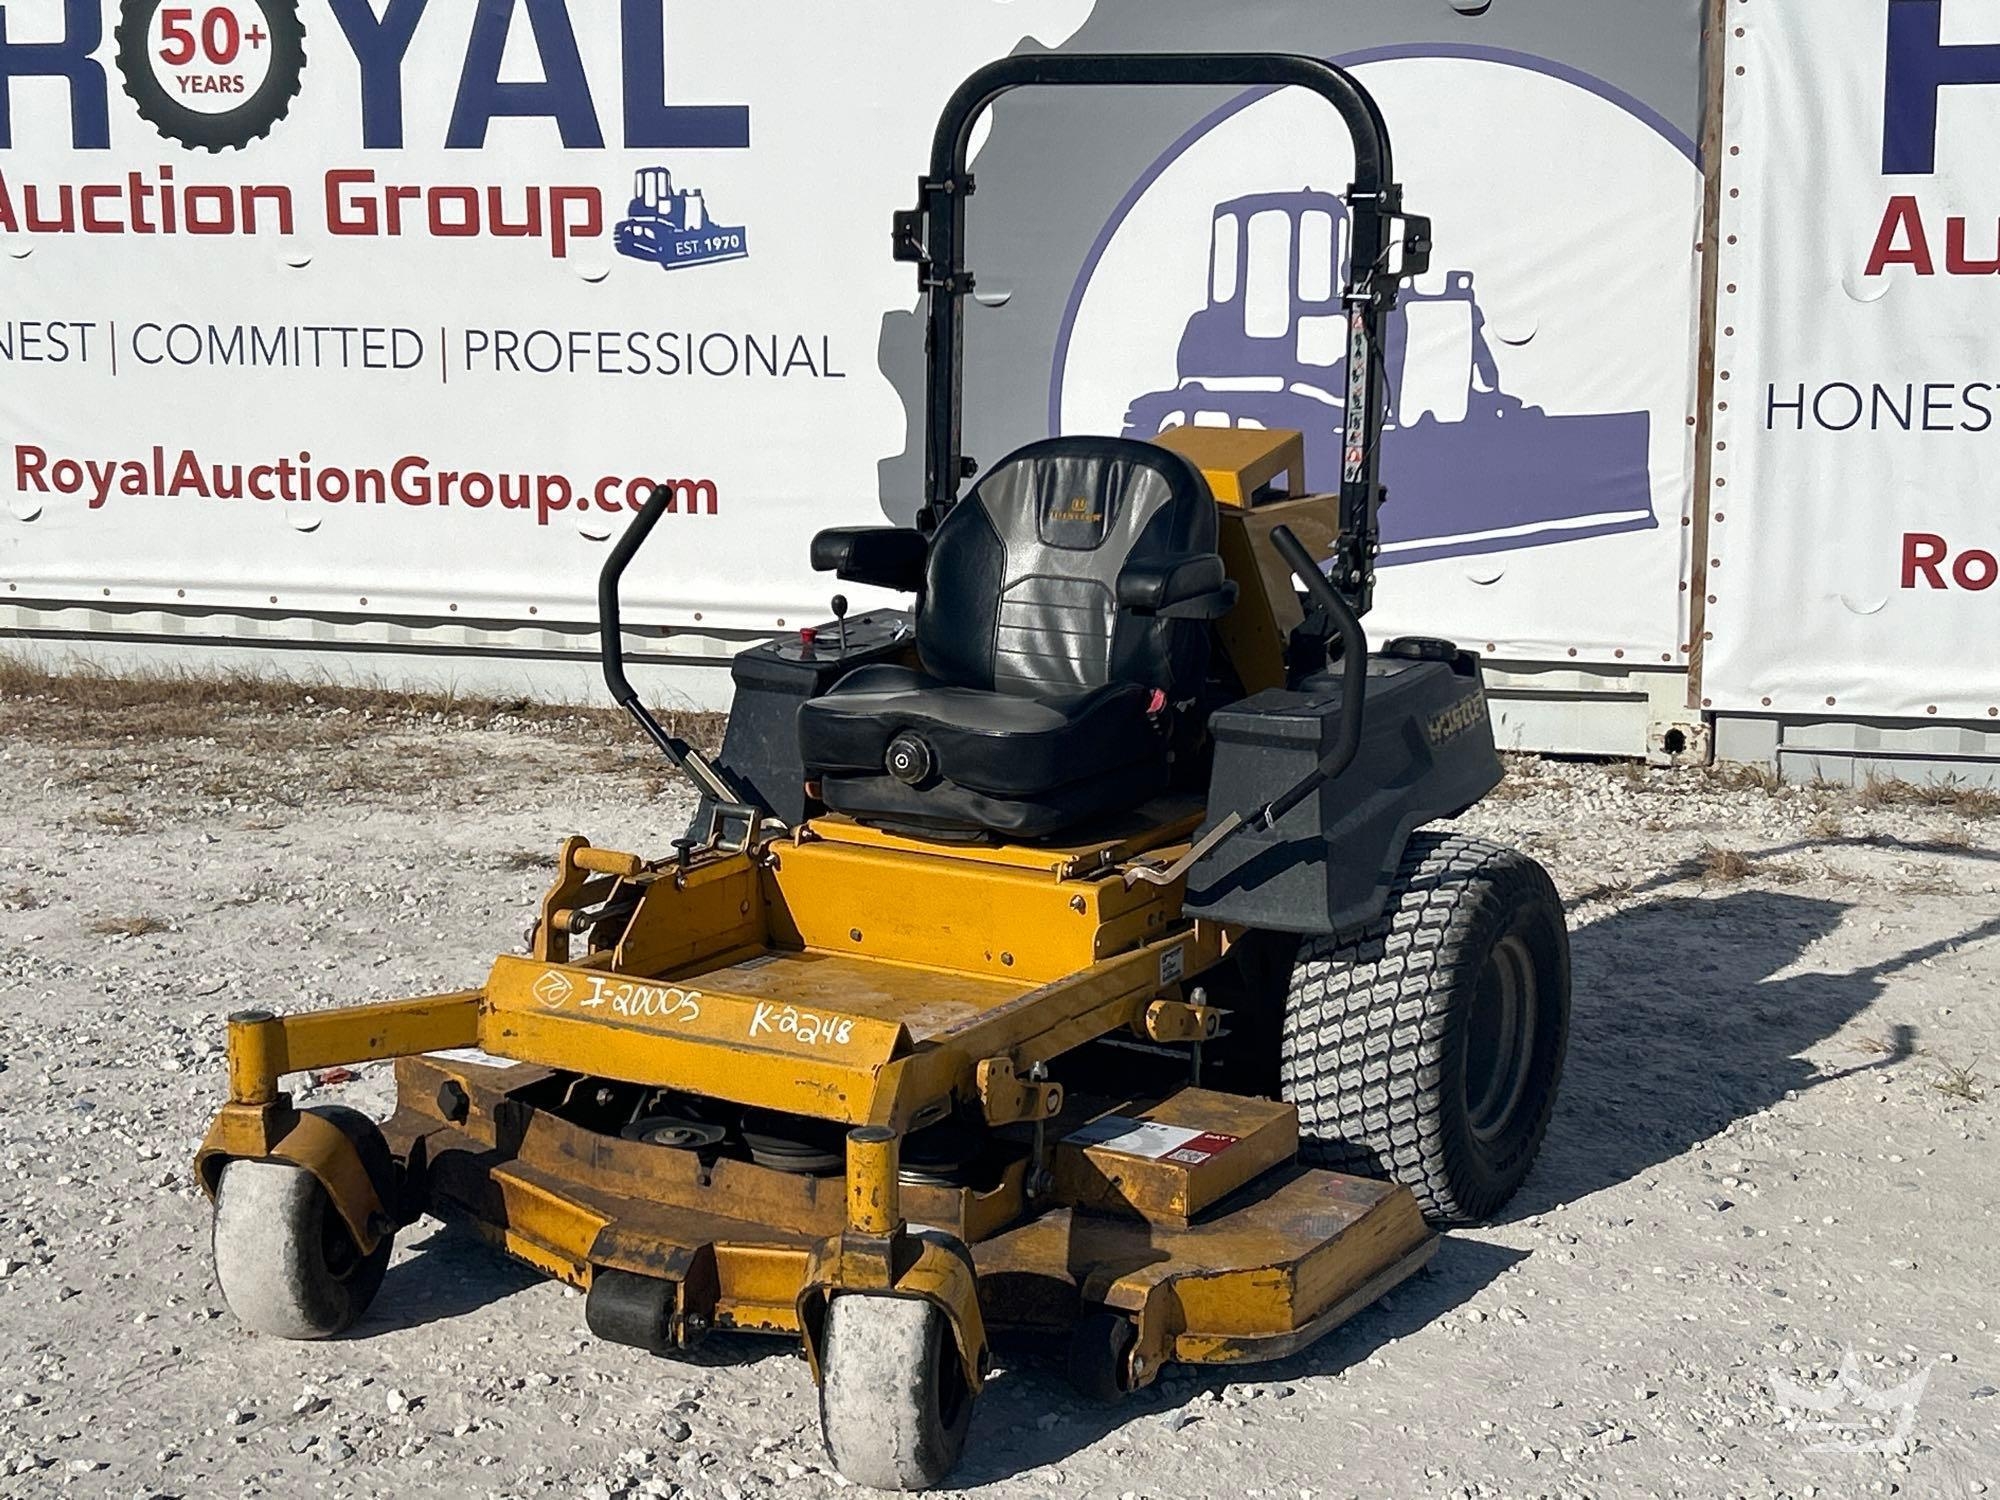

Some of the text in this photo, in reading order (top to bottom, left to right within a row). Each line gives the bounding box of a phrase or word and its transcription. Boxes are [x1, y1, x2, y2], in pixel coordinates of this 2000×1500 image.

[159, 6, 266, 66] 50+
[176, 75, 245, 94] YEARS
[325, 169, 603, 258] Group
[676, 234, 740, 255] EST. 1970
[132, 322, 424, 370] COMMITTED
[465, 328, 847, 378] PROFESSIONAL
[1767, 382, 2000, 432] HONES
[14, 444, 718, 526] RoyalAuctionGroup.com
[1901, 532, 1999, 591] Ro
[749, 1002, 856, 1045] K-2248
